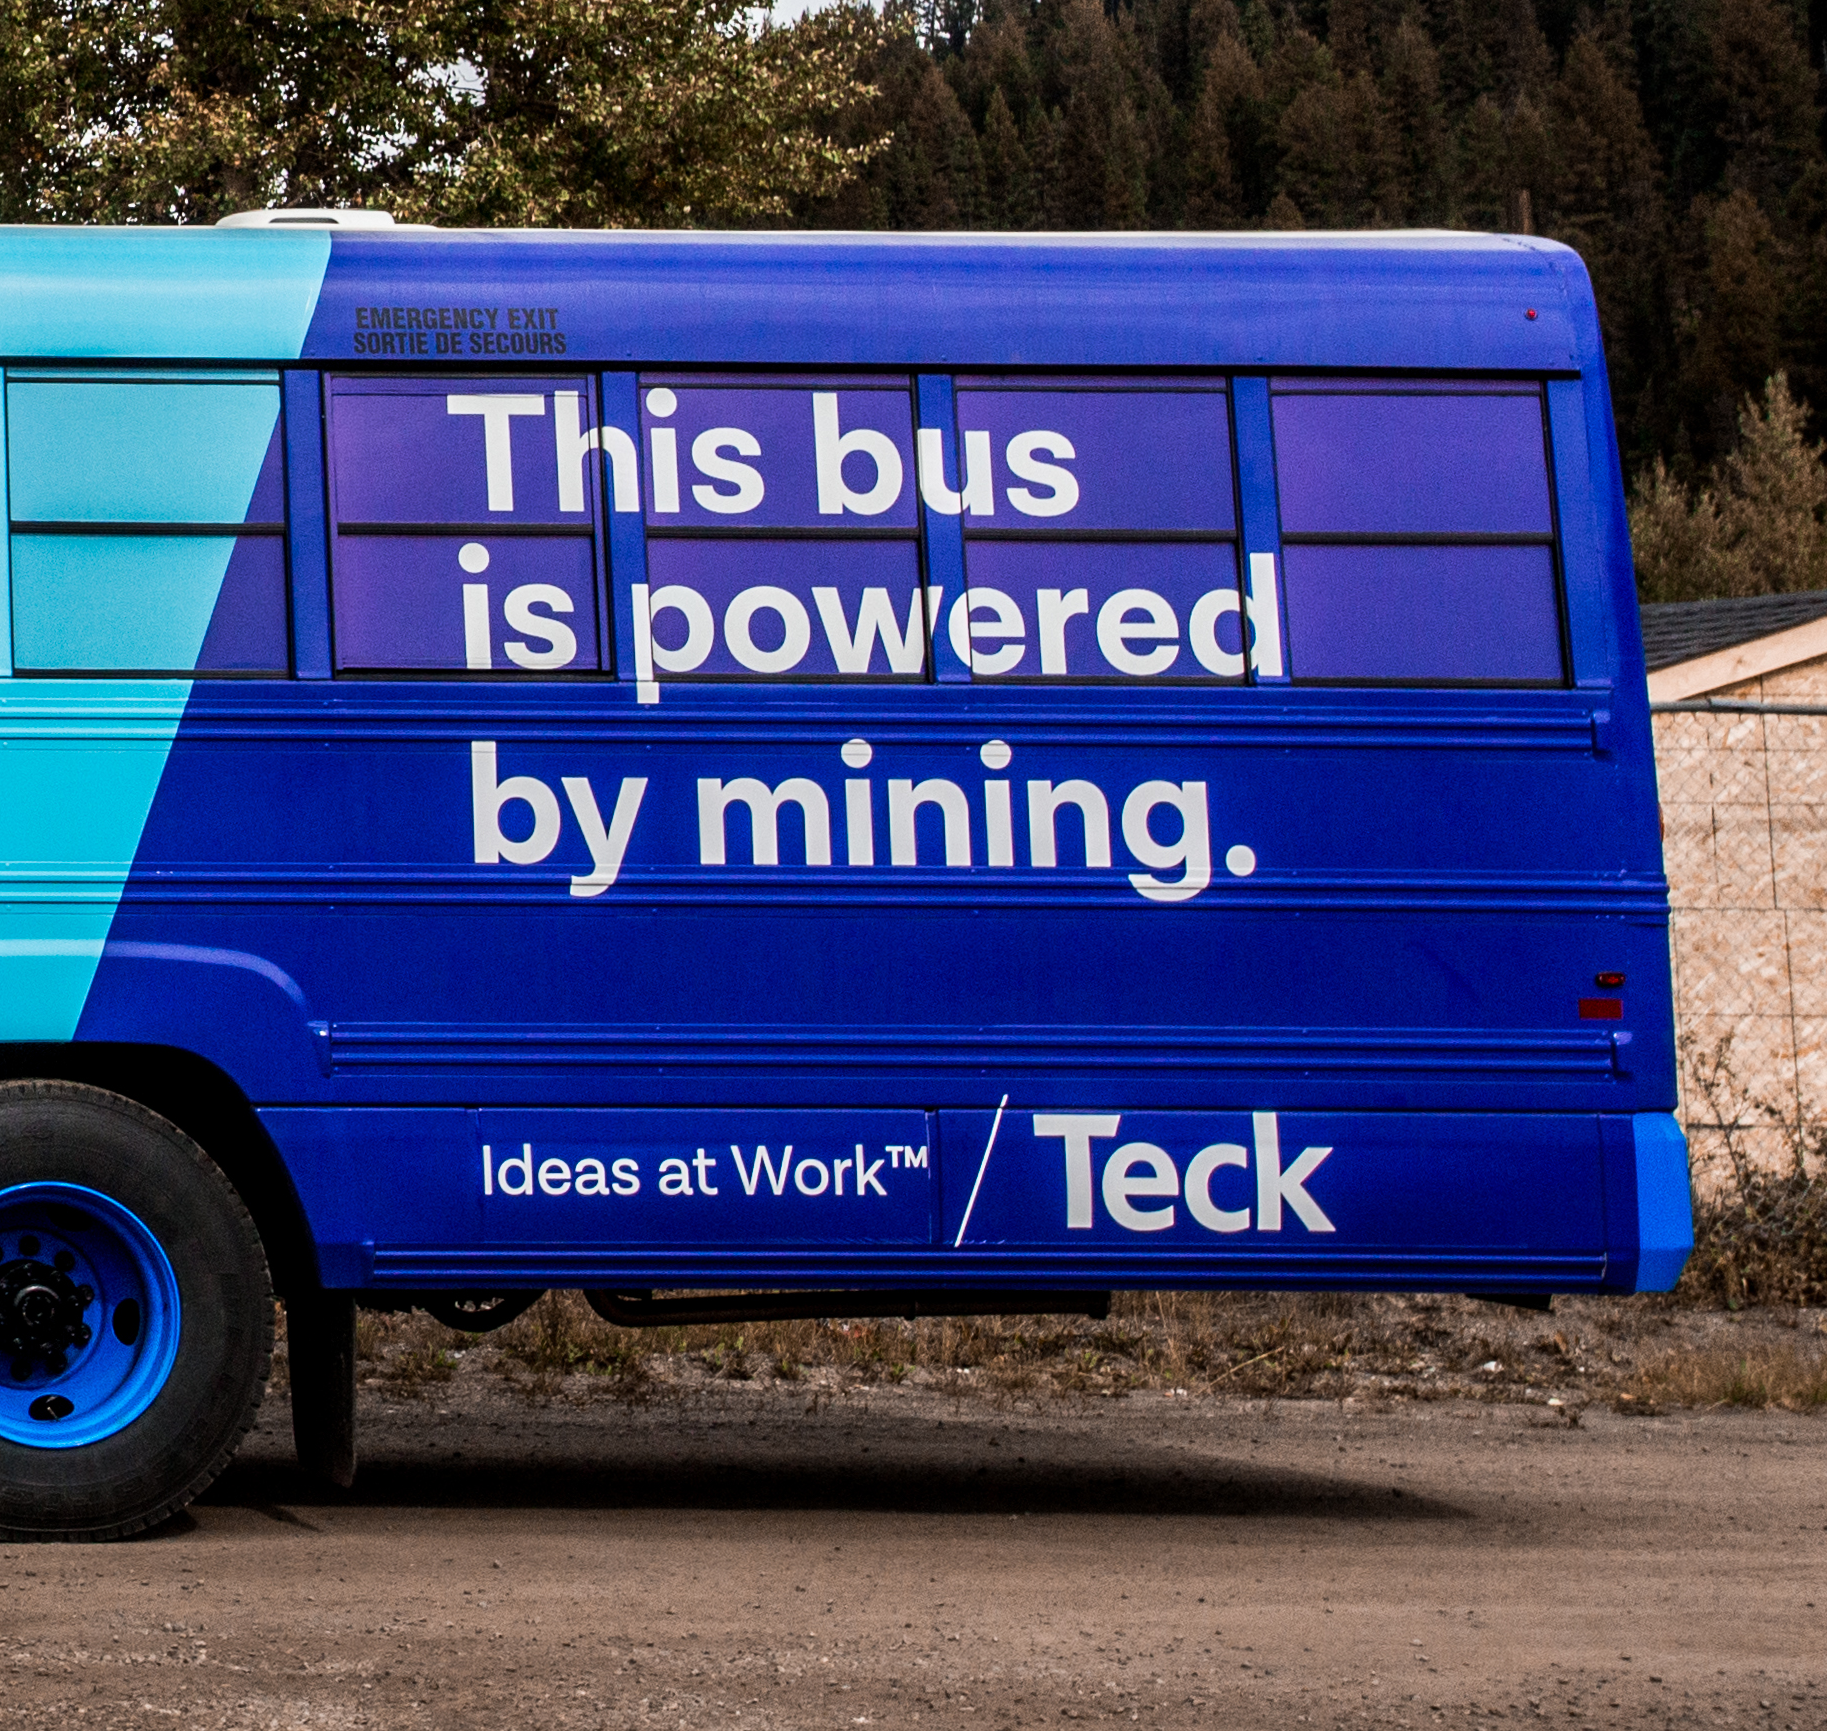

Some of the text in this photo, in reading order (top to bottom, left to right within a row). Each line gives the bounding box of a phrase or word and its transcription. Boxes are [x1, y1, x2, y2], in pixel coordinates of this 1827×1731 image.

[353, 332, 567, 355] SORTIE DE SECOURS
[355, 307, 558, 330] EMERGENCY EXIT
[446, 387, 1080, 517] This bus
[458, 542, 1283, 704] is powered
[471, 738, 1256, 902] by mining.
[482, 1143, 640, 1195] Ideas
[658, 1148, 718, 1196] at
[1033, 1111, 1336, 1232] Teck
